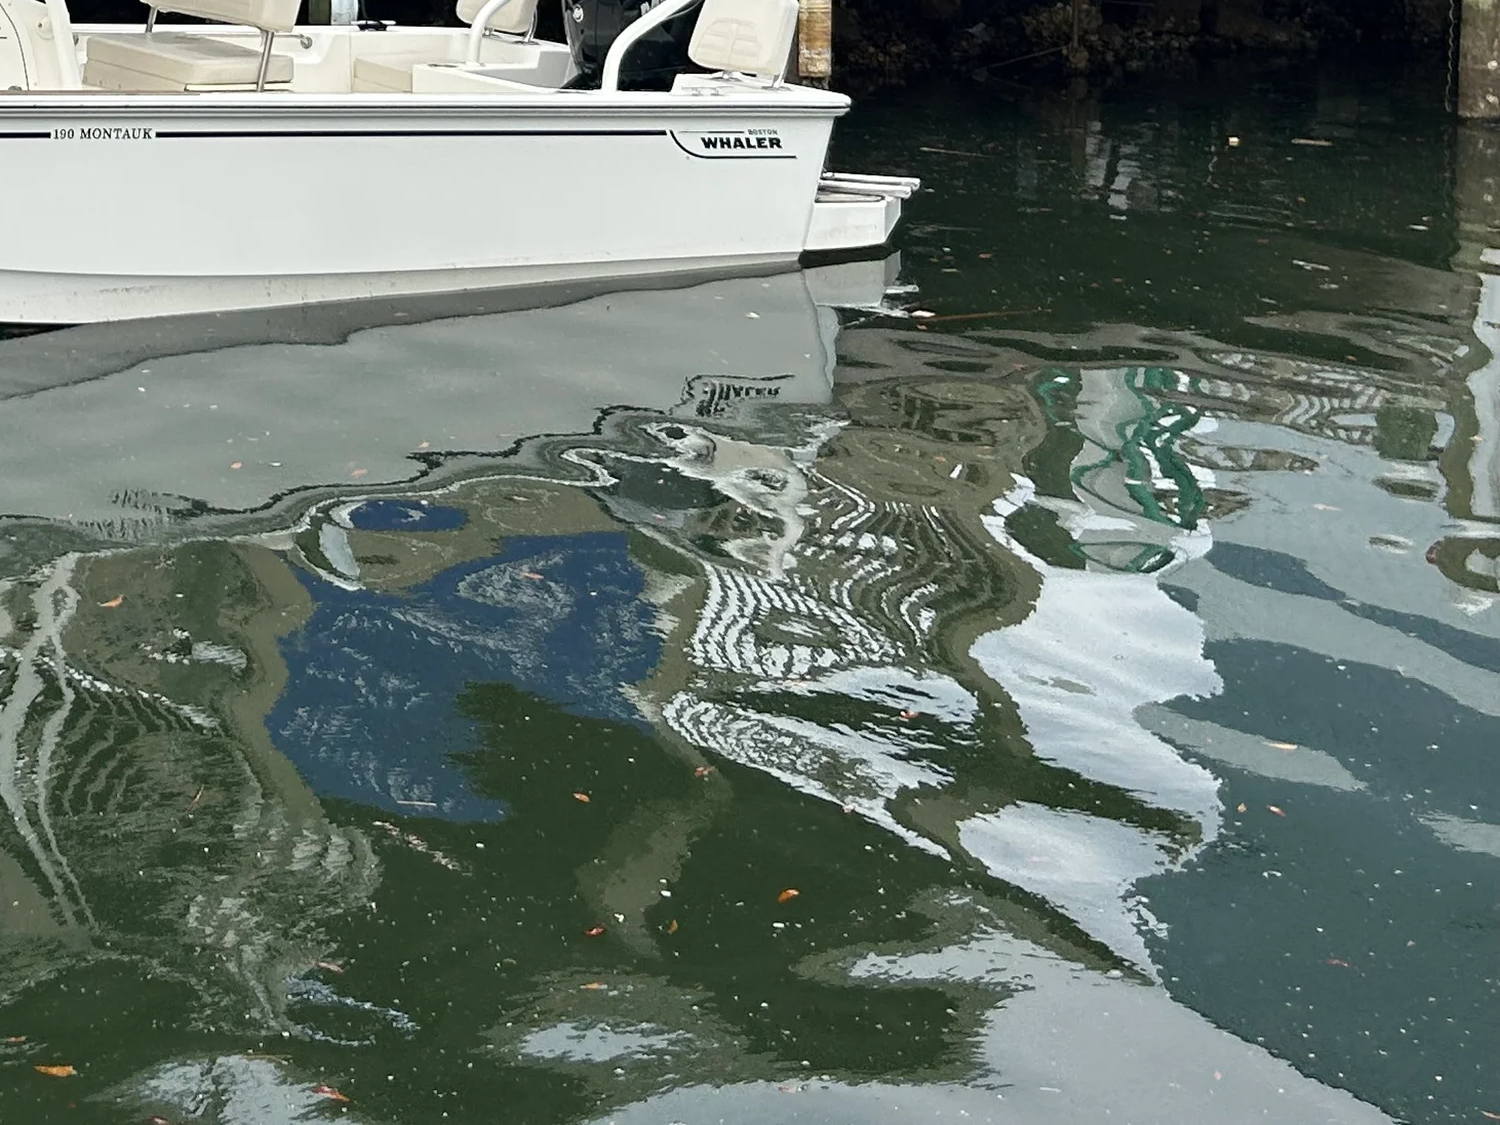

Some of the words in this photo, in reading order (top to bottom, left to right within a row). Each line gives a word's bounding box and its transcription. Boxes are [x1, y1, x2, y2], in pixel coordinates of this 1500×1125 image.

[53, 128, 75, 140] 190
[79, 128, 153, 140] MONTAUK
[700, 137, 783, 149] WHALER
